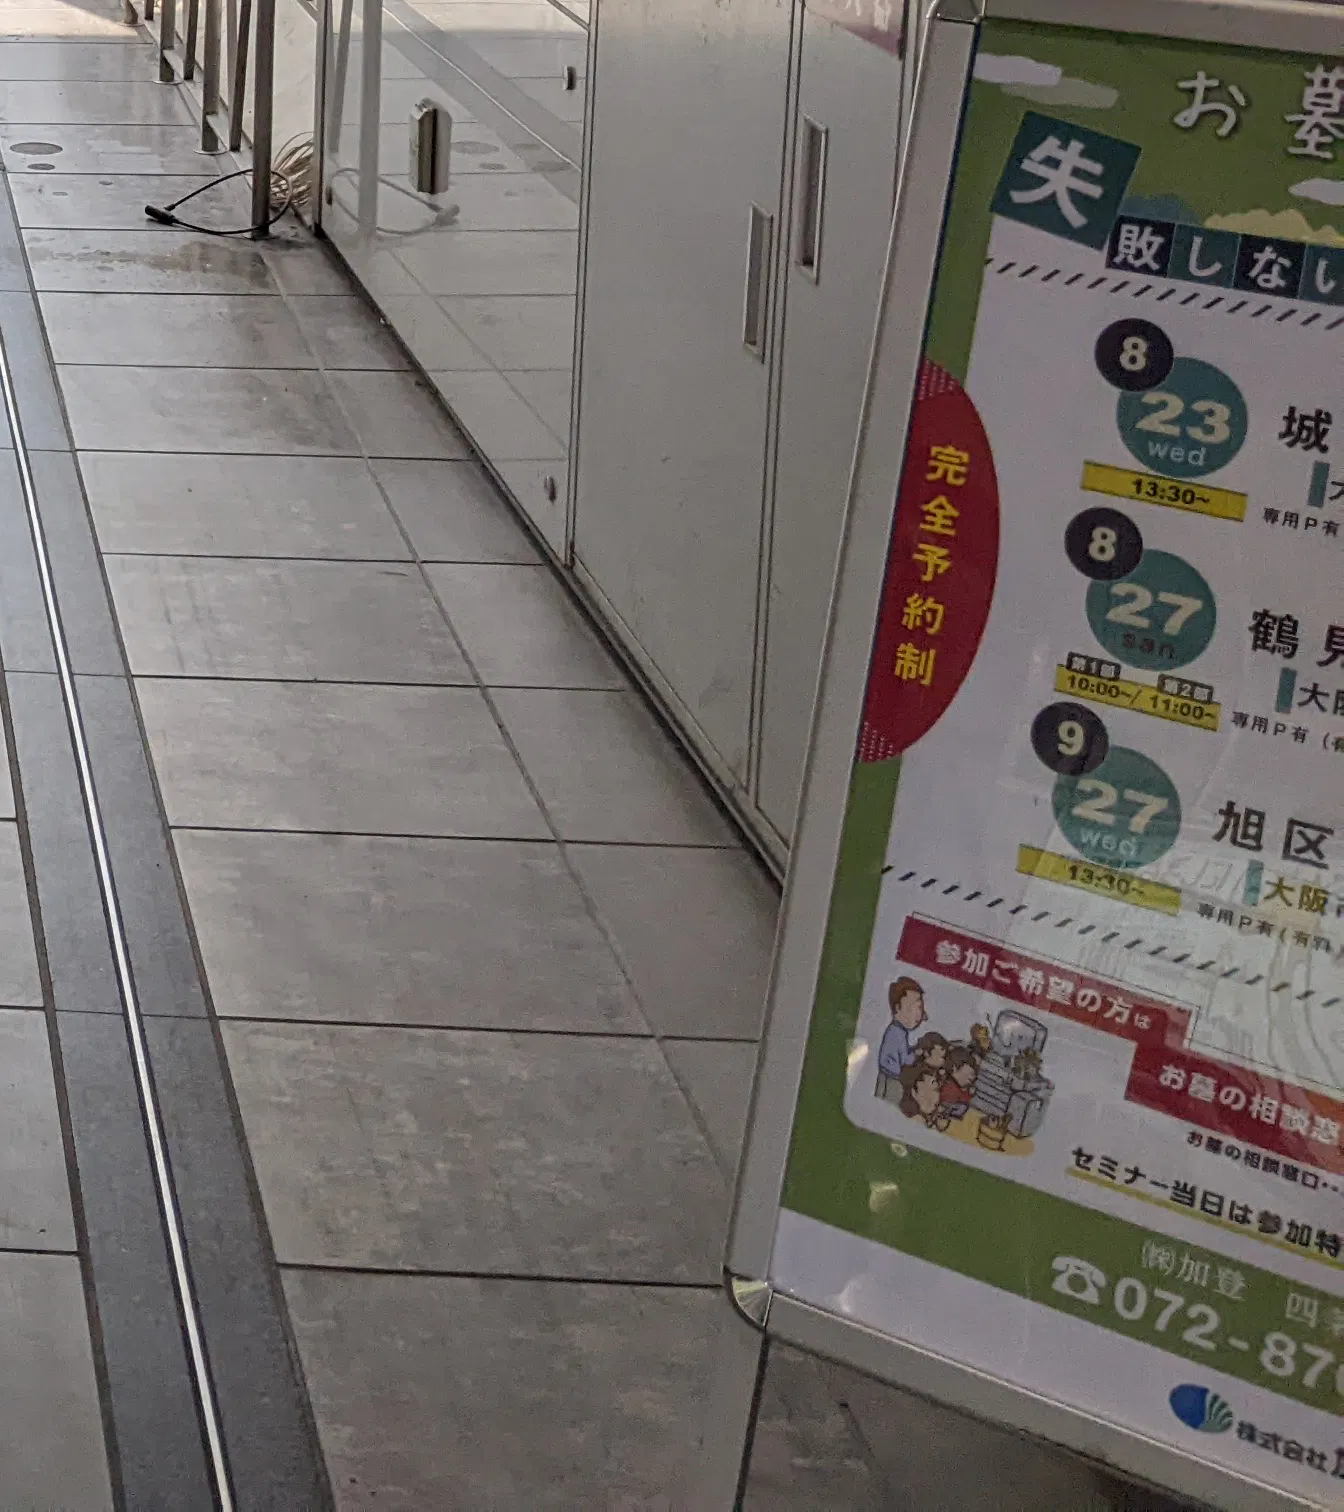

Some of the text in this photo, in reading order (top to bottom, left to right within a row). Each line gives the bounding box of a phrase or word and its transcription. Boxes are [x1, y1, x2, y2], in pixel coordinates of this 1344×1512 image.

[1119, 336, 1148, 372] 8
[1135, 391, 1231, 444] 23
[1278, 406, 1333, 454] 城
[894, 444, 970, 686] 完全予約制
[1088, 526, 1118, 562] 8
[1105, 582, 1203, 637] 27
[1056, 720, 1085, 756] 9
[1071, 778, 1169, 834] 27
[1211, 799, 1335, 870] 旭区
[935, 939, 1152, 1030] 参加ご希望の方は
